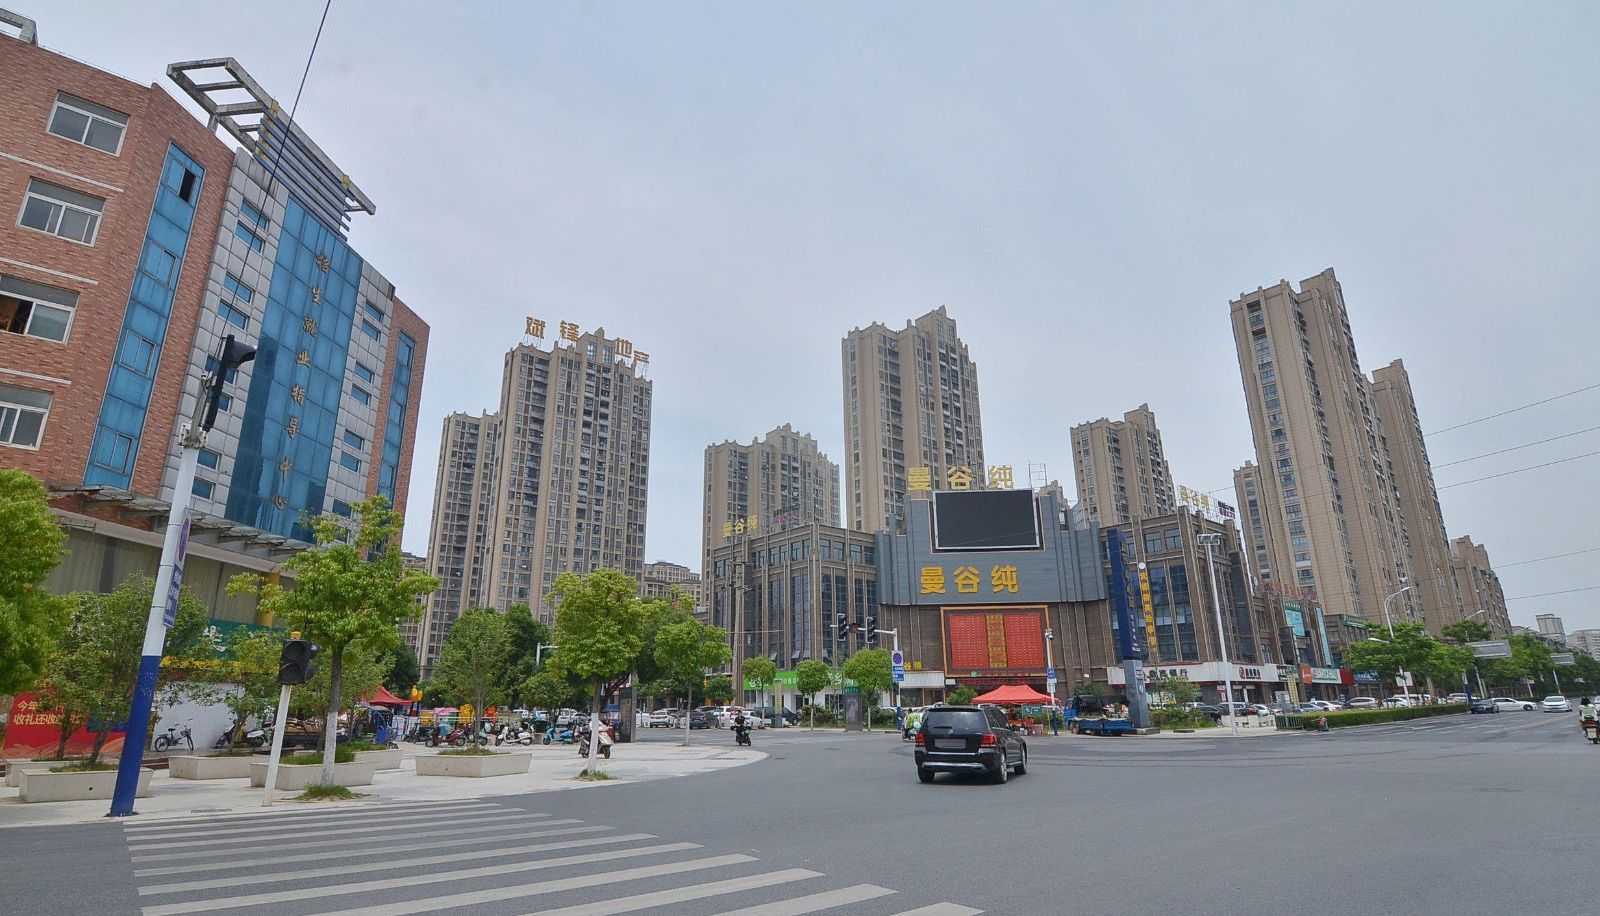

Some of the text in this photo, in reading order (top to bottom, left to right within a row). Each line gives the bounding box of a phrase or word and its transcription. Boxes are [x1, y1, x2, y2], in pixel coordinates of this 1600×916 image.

[525, 316, 650, 367] 斌锋地产
[272, 251, 330, 511] 招生就业指导中心
[907, 464, 1013, 491] 曼谷纯
[920, 564, 1020, 595] 曼谷纯
